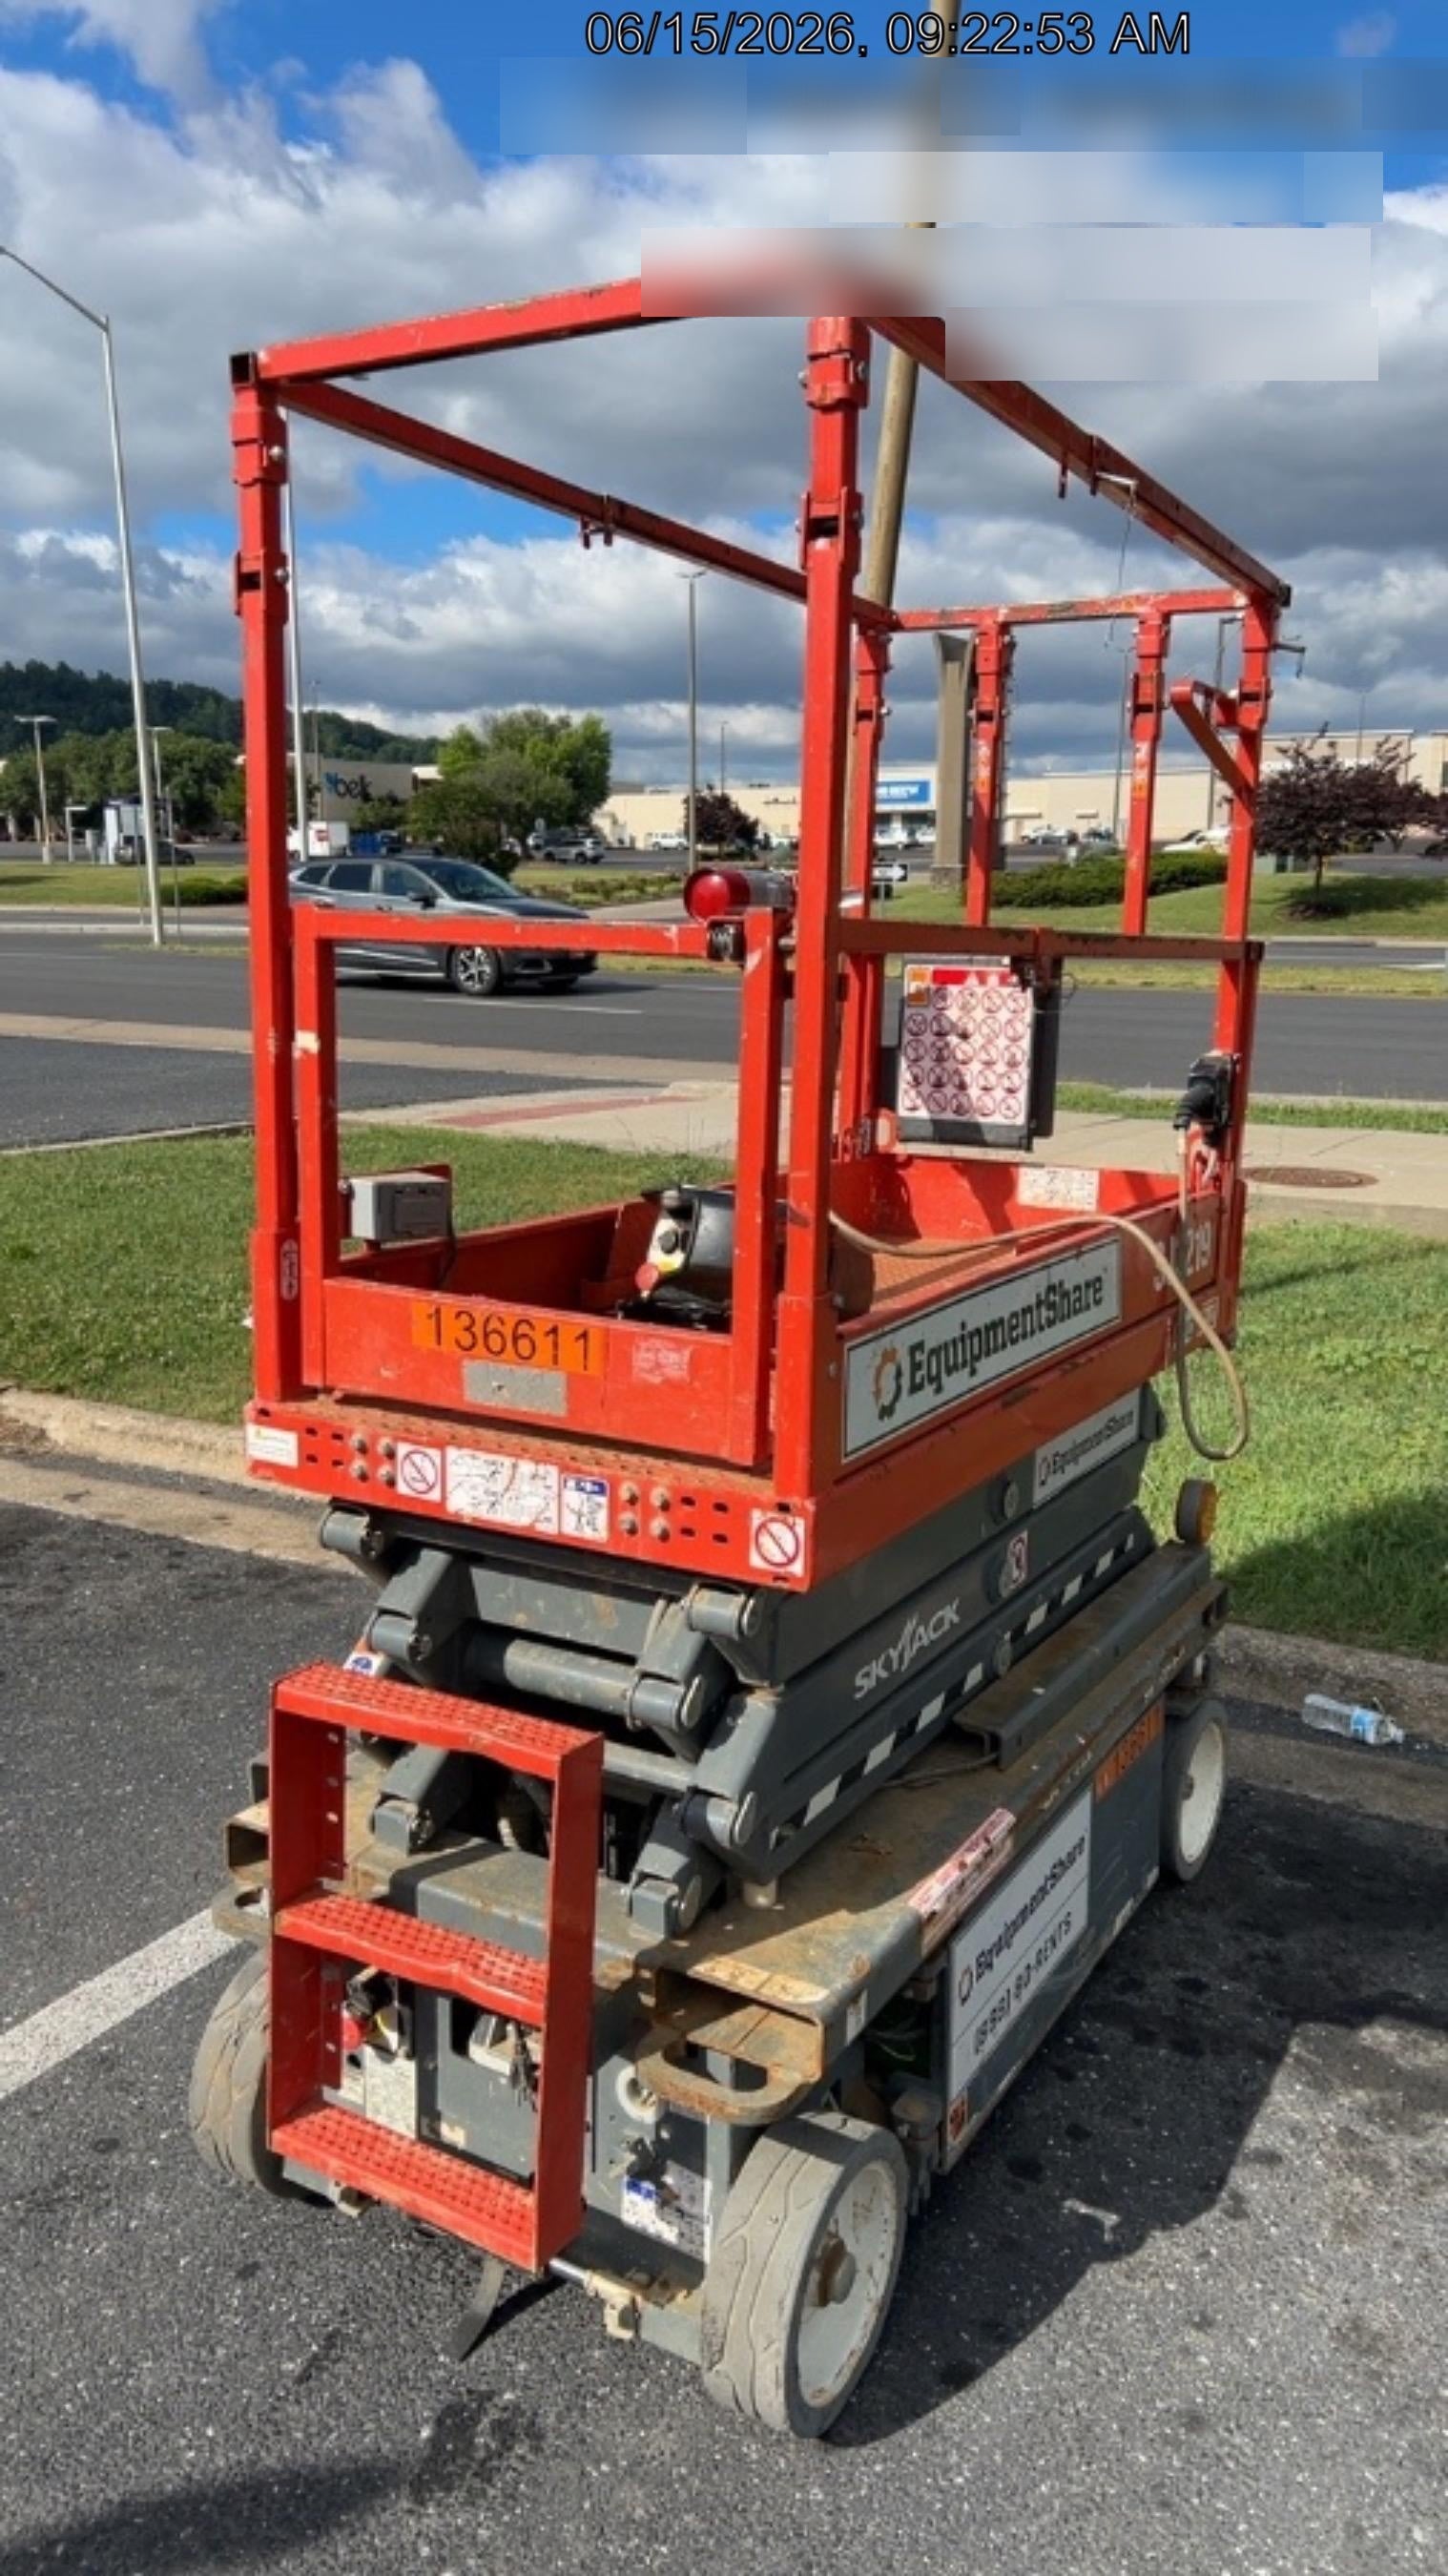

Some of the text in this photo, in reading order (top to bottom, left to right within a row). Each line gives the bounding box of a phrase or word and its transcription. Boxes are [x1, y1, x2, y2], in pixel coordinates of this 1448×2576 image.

[425, 1306, 590, 1372] 136611
[907, 1275, 1104, 1395] EquipmentShare
[855, 1597, 961, 1700] SKYJACK
[974, 1836, 1086, 1984] EquipmentShare
